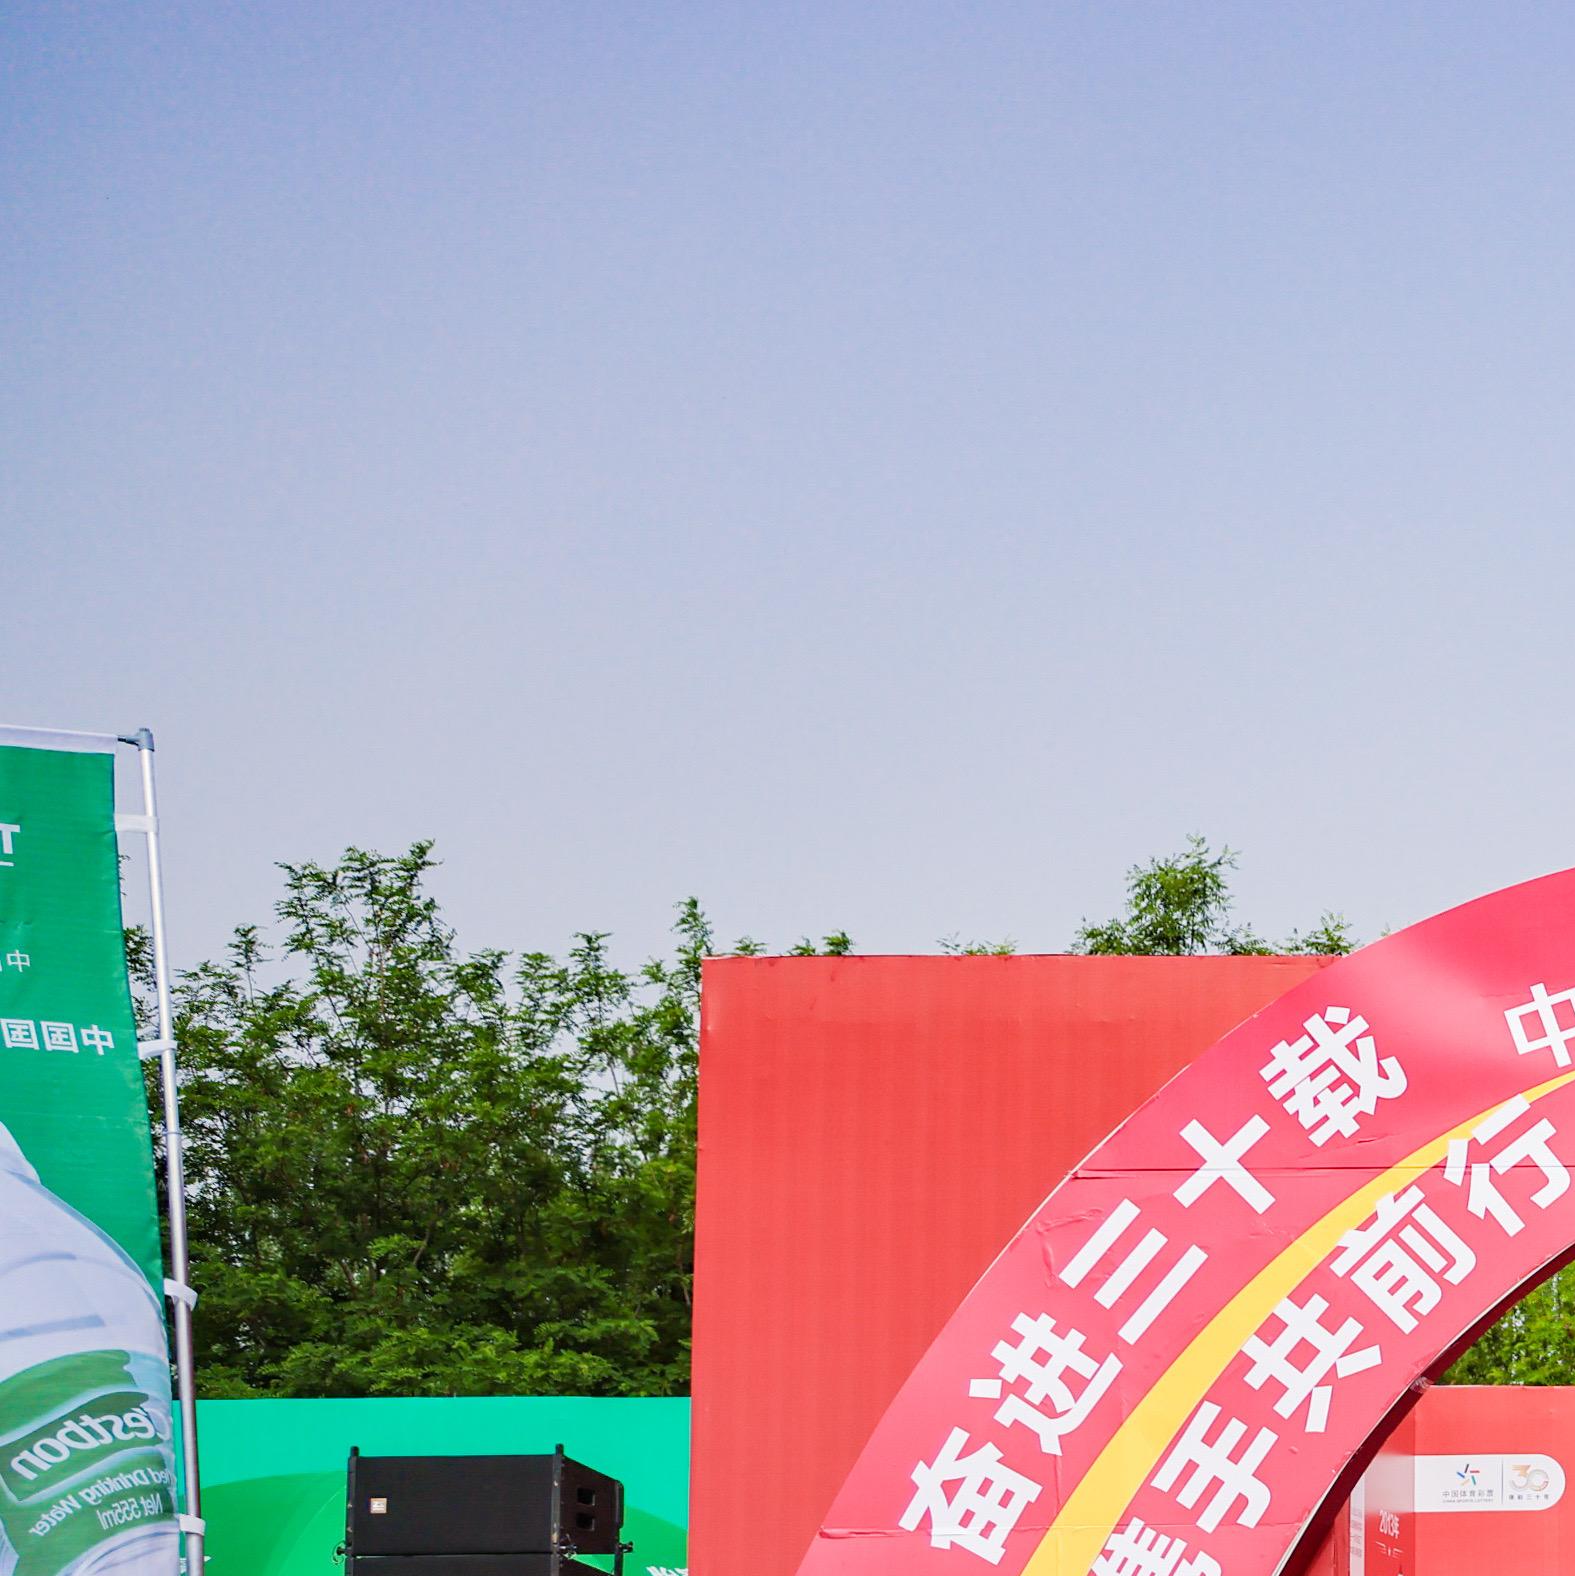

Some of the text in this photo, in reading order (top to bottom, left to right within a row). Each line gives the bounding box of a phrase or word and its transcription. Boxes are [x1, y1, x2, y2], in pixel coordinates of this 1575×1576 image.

[899, 1006, 1408, 1566] 奋进三十载
